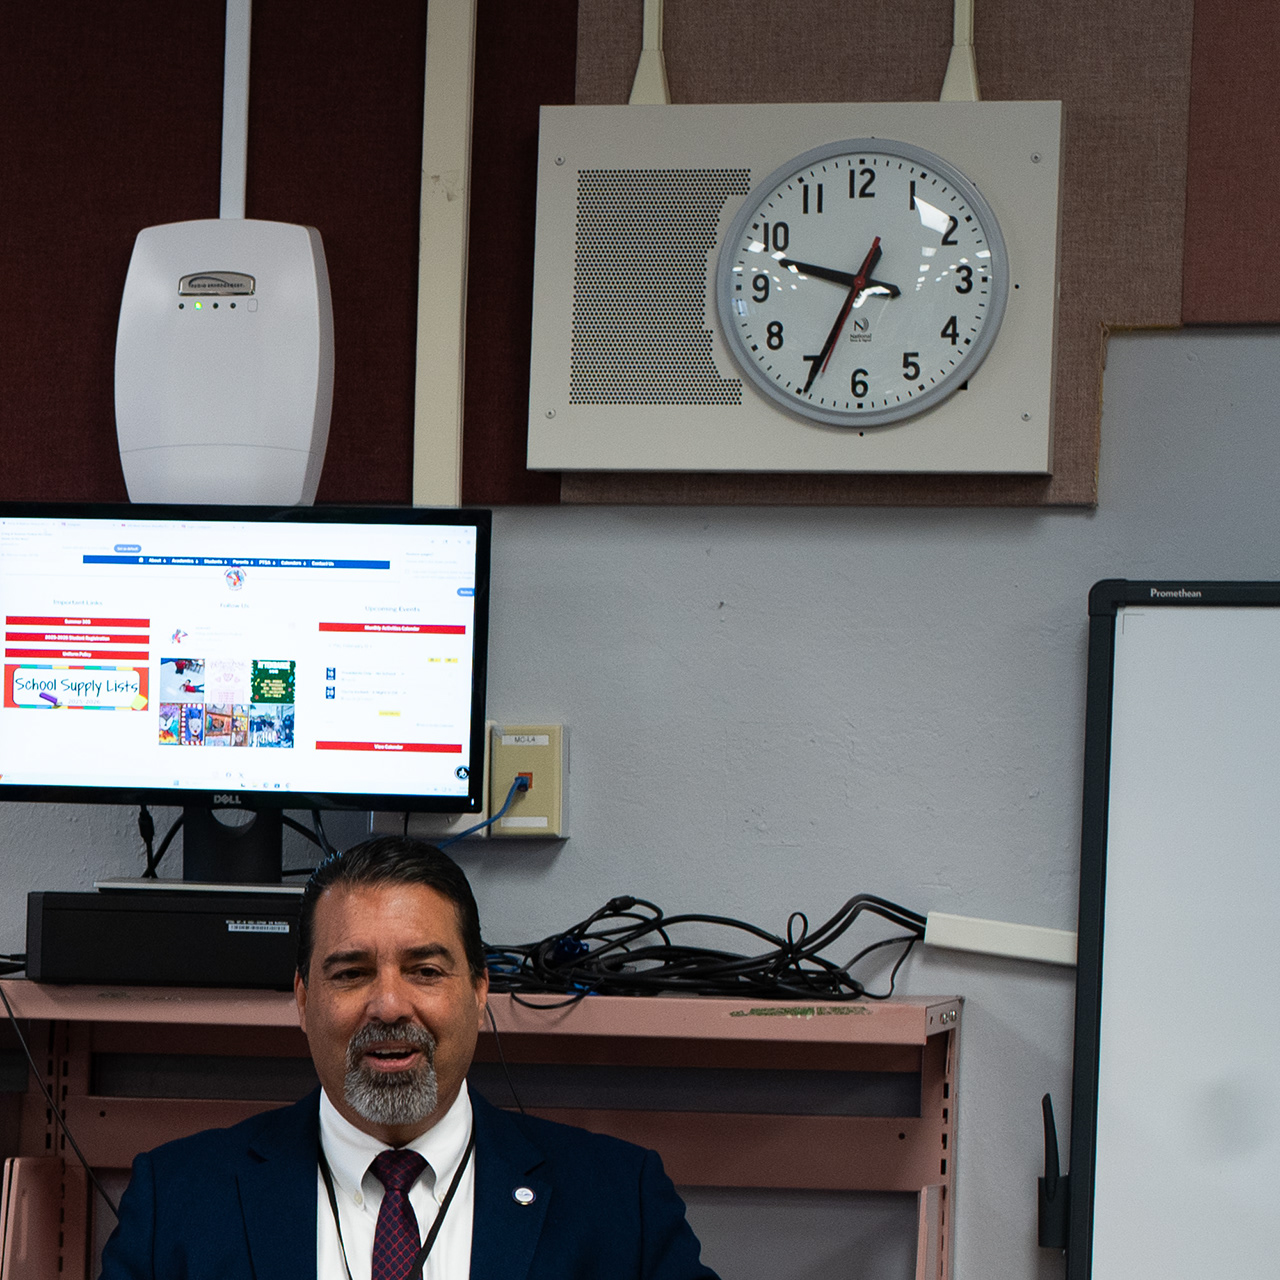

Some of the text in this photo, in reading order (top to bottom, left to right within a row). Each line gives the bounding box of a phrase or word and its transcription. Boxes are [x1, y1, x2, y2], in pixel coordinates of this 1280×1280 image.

[849, 168, 876, 198] 12
[908, 182, 916, 210] 1
[802, 184, 824, 213] 11
[762, 222, 790, 252] 10
[941, 216, 958, 246] 2
[752, 274, 770, 303] 9
[956, 265, 972, 293] 3
[766, 322, 784, 349] 8
[941, 316, 958, 345] 4
[902, 352, 920, 380] 5
[851, 369, 869, 397] 6
[1149, 587, 1202, 598] Promethean
[15, 678, 138, 697] School Supply Lists
[213, 794, 241, 805] DELL
